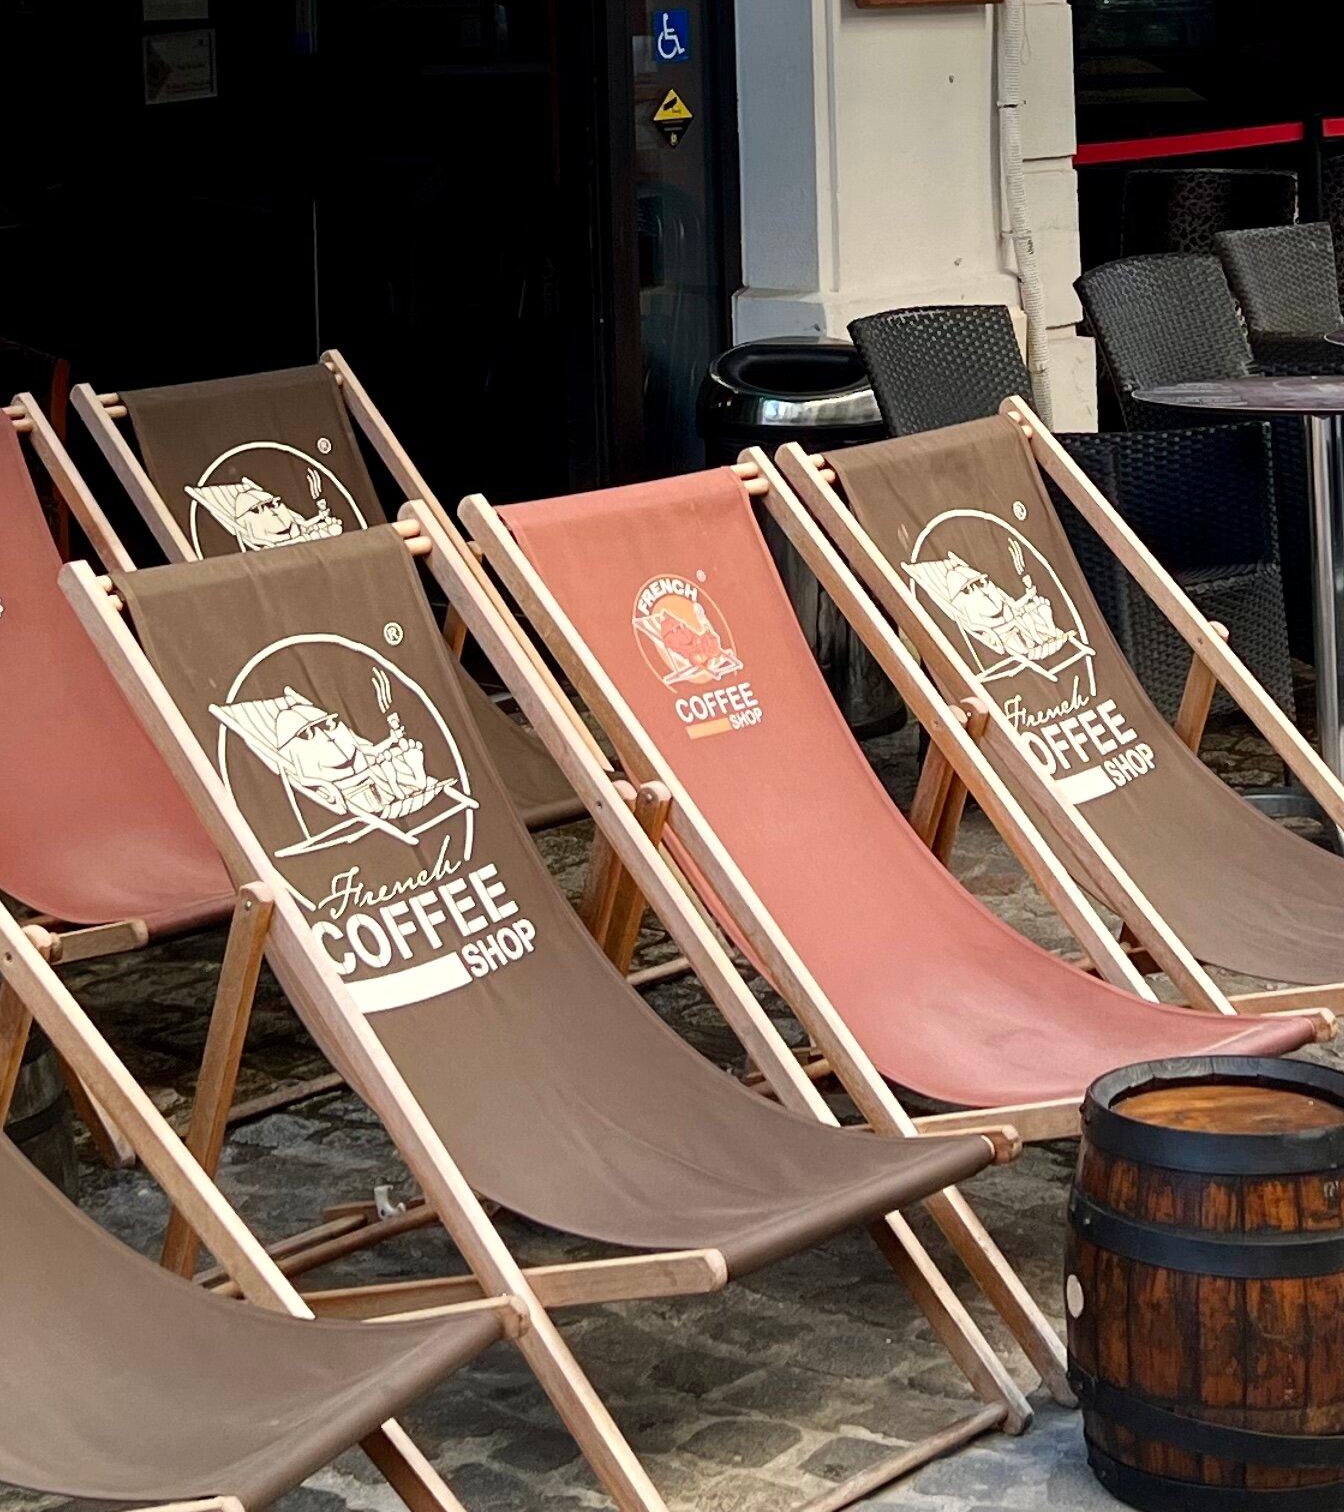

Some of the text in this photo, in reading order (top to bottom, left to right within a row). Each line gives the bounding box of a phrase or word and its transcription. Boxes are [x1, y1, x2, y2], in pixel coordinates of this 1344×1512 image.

[638, 577, 698, 617] FRENCH
[674, 681, 759, 724] COFFEE
[730, 706, 763, 731] SHOP
[1004, 677, 1089, 729] French
[1022, 698, 1139, 778] OFFEE
[1107, 743, 1155, 789] SHOP
[318, 835, 462, 920] French
[310, 862, 519, 976] COFFEE
[461, 917, 536, 981] SHOP
